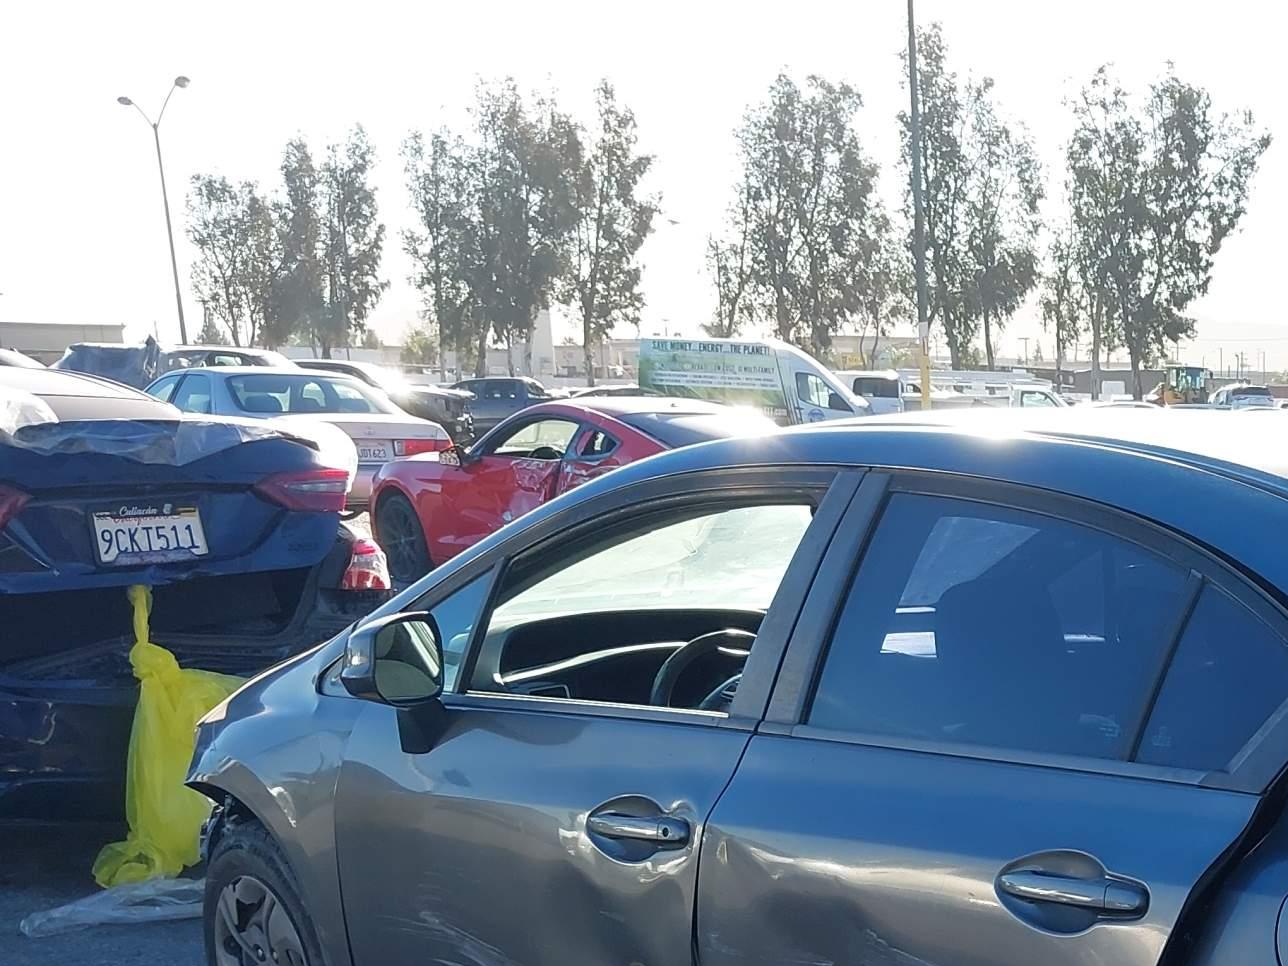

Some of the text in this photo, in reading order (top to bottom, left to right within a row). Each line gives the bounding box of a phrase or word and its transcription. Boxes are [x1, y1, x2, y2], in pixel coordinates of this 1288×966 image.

[652, 341, 670, 351] SAVE
[743, 345, 770, 356] PLANET!
[100, 524, 200, 554] 9CKT511
